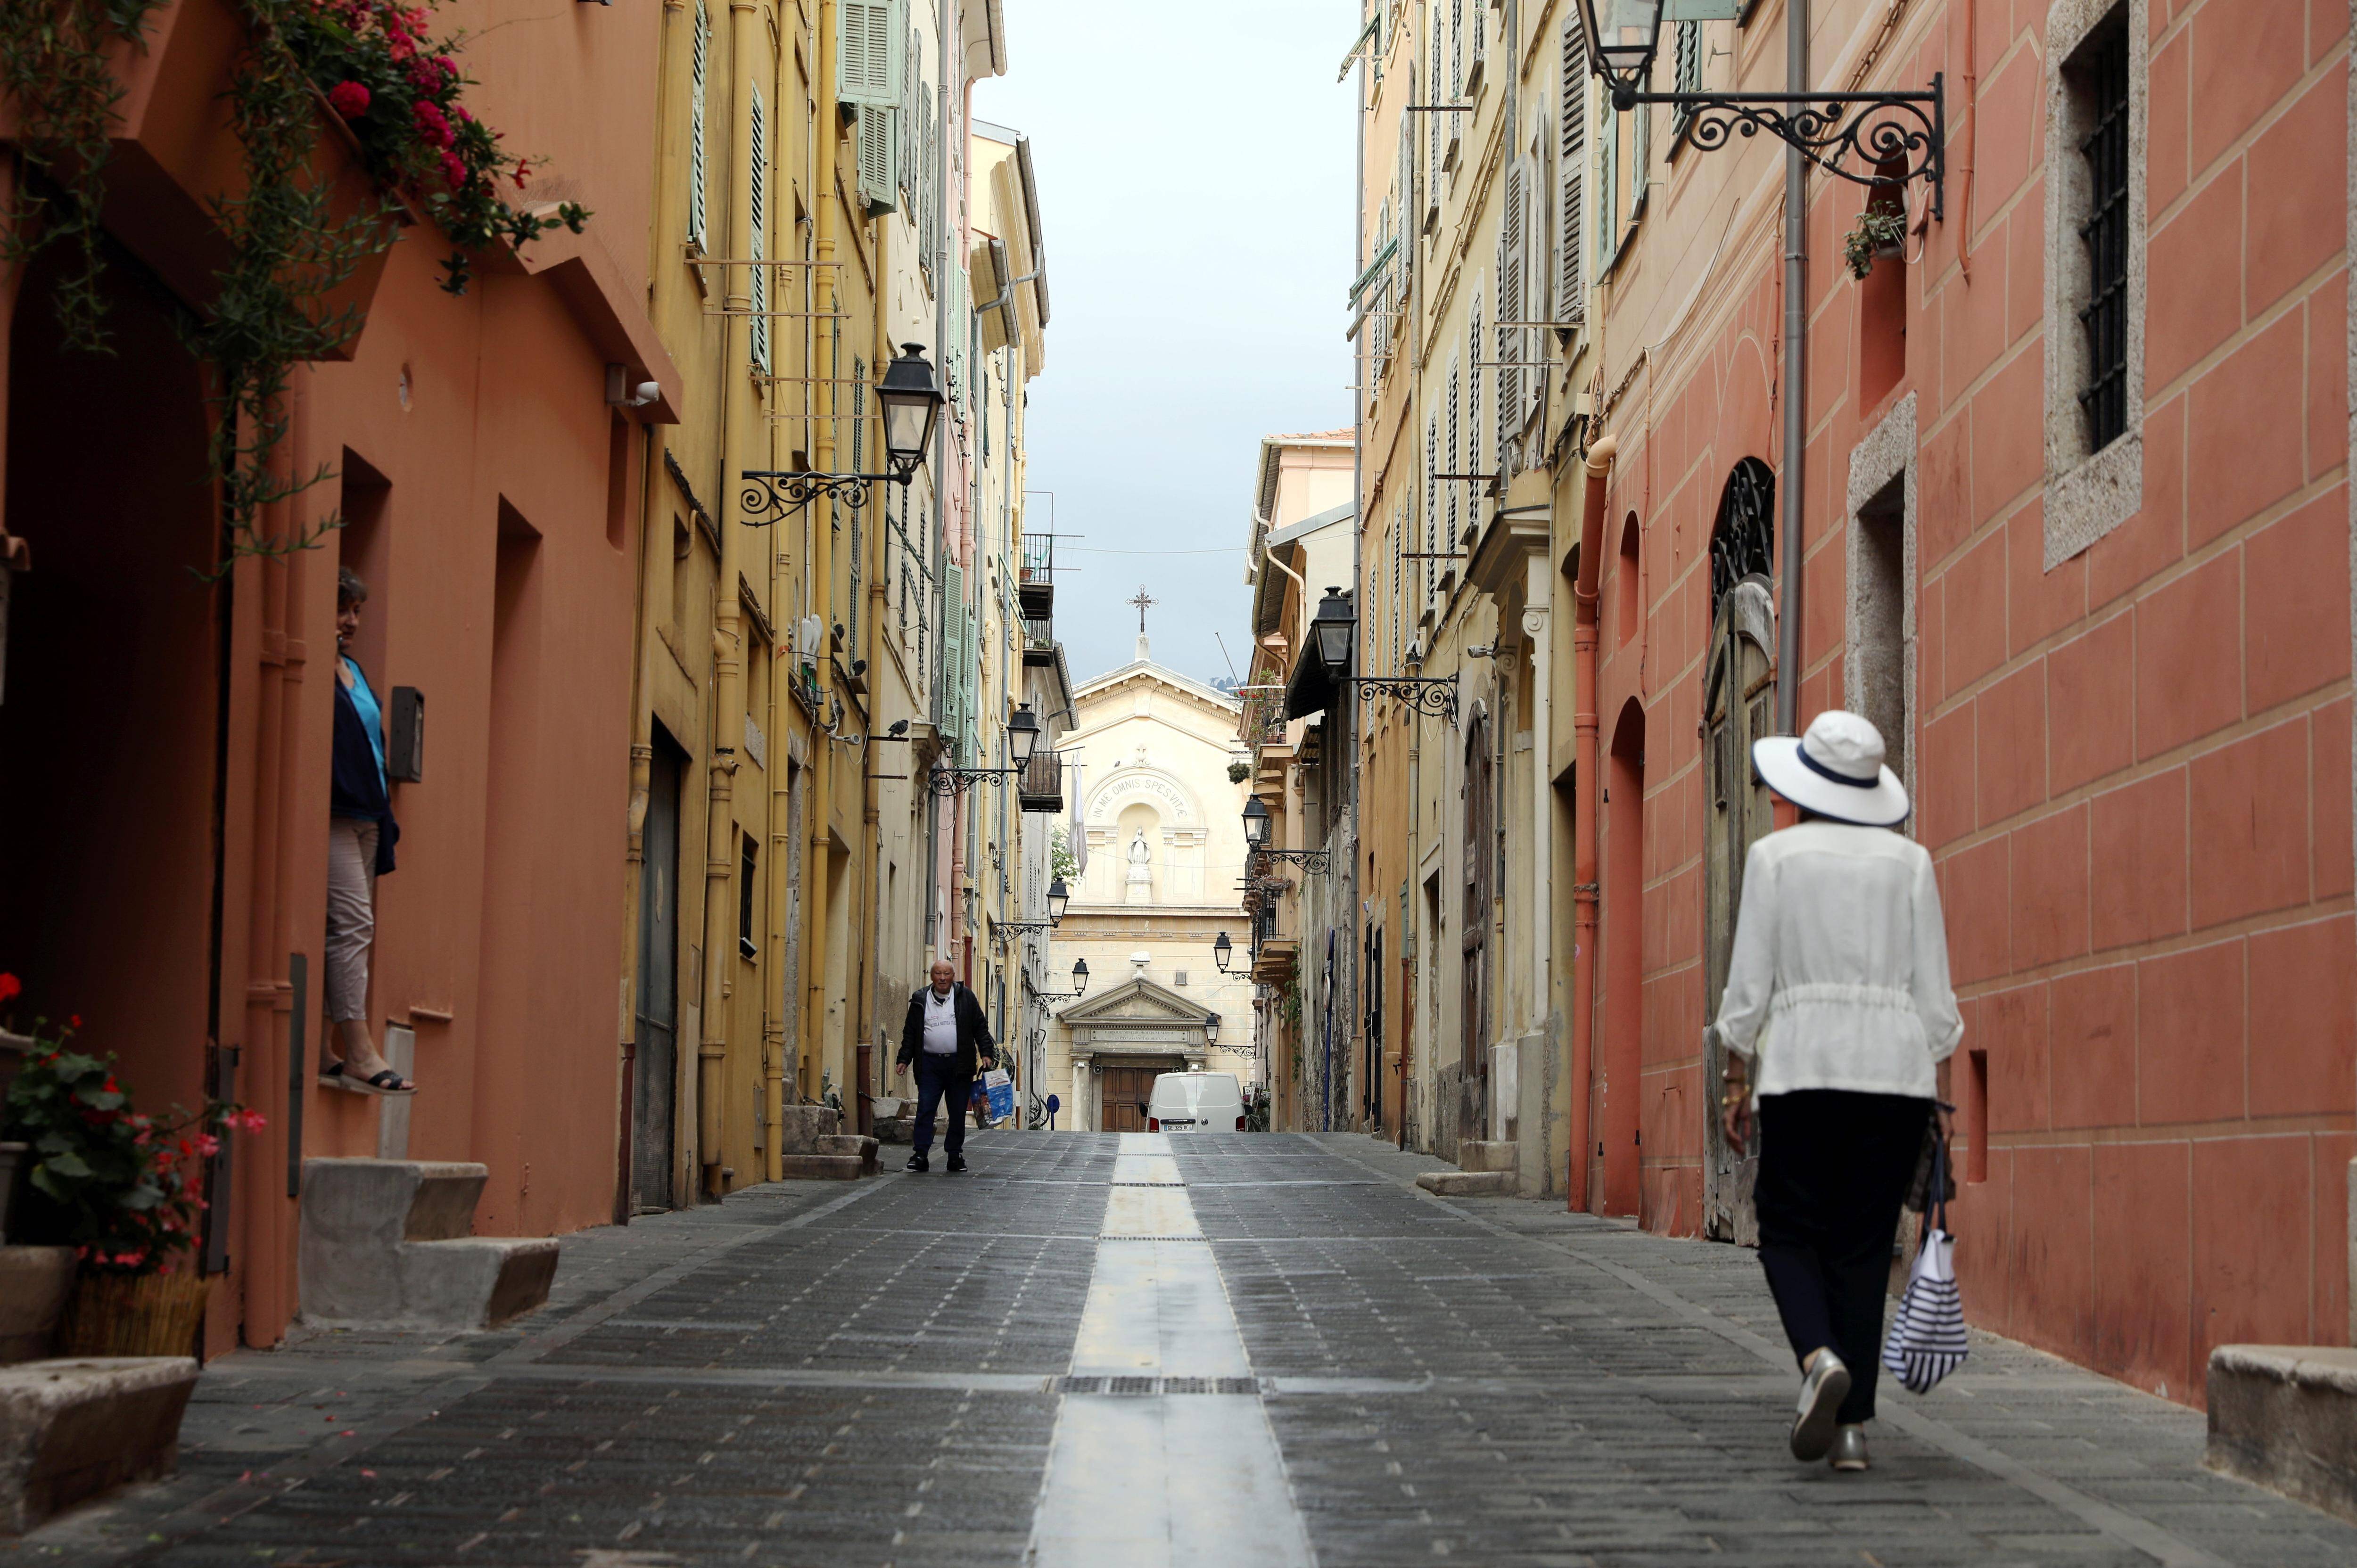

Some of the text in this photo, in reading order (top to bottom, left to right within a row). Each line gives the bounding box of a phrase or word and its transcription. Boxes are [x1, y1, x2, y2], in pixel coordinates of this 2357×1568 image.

[1112, 779, 1140, 795] OMNIS
[1145, 780, 1171, 797] SPES
[1098, 793, 1113, 807] ME
[1093, 807, 1104, 818] IN
